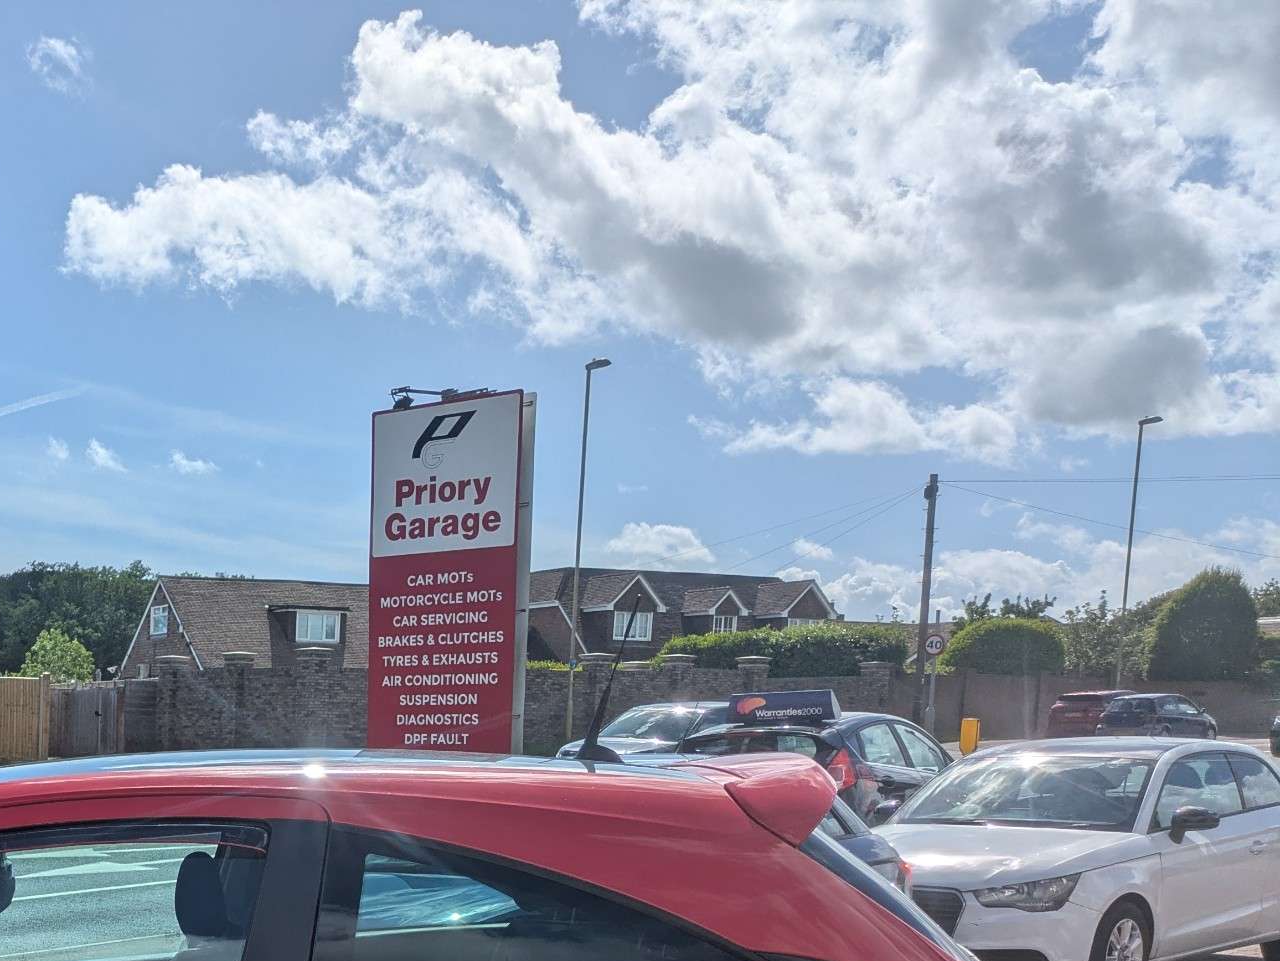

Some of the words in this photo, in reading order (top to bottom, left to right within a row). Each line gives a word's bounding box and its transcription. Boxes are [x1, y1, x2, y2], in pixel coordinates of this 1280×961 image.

[395, 475, 492, 507] Priory
[384, 510, 502, 542] Garage
[407, 574, 433, 587] CAR
[437, 571, 474, 585] MOTs
[380, 592, 463, 608] MOTORCYCLE
[466, 589, 503, 603] MOTs
[393, 615, 418, 627] CAR
[420, 611, 488, 626] SERVICING
[378, 634, 424, 647] BRAKES
[427, 634, 435, 646] &
[438, 630, 504, 645] CLUTCHES
[927, 640, 941, 649] 40
[382, 655, 418, 667] TYRES
[421, 654, 429, 666] &
[432, 652, 498, 666] EXHAUSTS
[382, 675, 402, 687] AIR
[404, 672, 498, 686] CONDITIONING
[399, 693, 478, 706] SUSPENSION
[396, 713, 479, 726] DIAGNOSTICS
[755, 707, 823, 717] Warranties2000
[404, 733, 427, 745] DPF
[430, 733, 469, 745] FAULT
